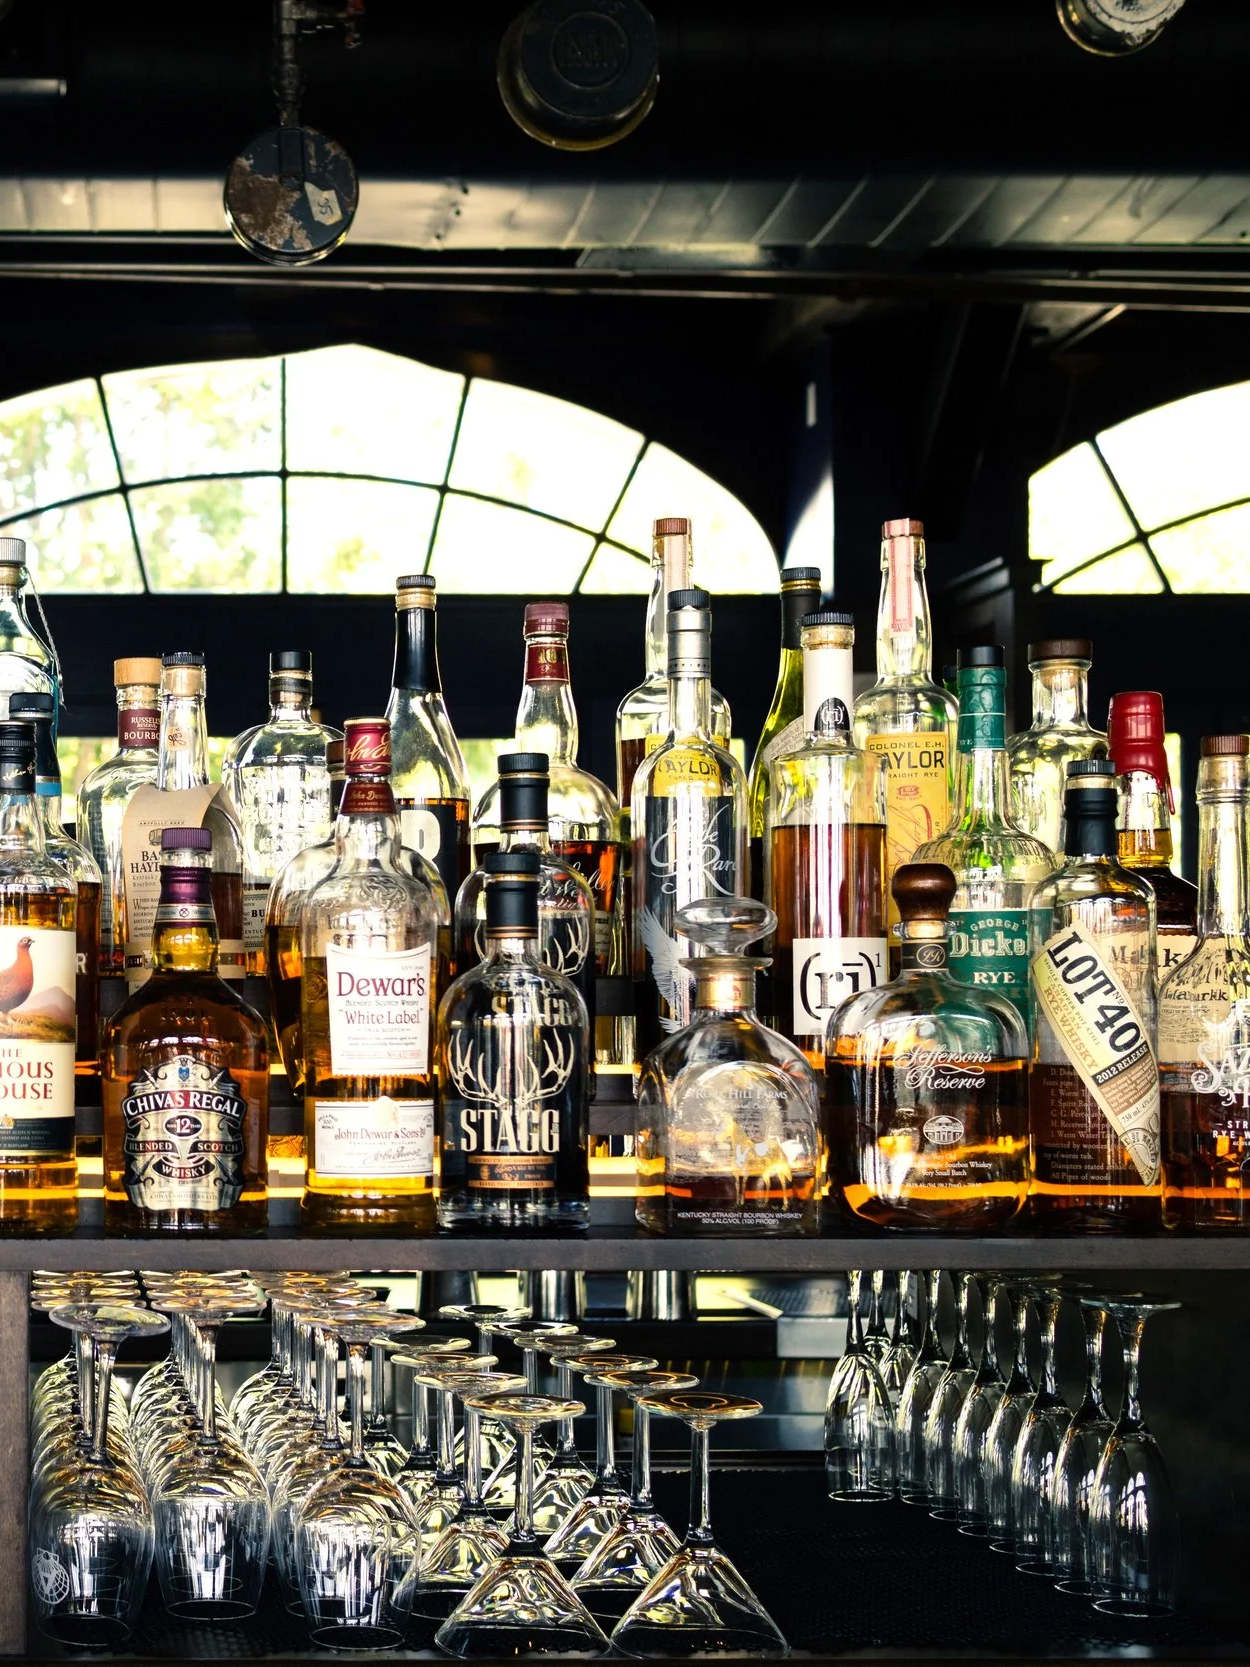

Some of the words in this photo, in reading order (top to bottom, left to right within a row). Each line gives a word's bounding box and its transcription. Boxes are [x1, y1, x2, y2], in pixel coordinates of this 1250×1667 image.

[124, 732, 160, 740] BOURBO
[870, 742, 920, 751] COLONEL
[925, 739, 945, 748] E.H.
[886, 750, 945, 769] AYLOR
[970, 918, 1020, 932] GEORGE
[336, 972, 425, 997] Dewar's
[973, 971, 1016, 984] RYE
[1044, 958, 1058, 982] SINGLE
[1057, 983, 1075, 1012] COPPER
[1075, 1012, 1085, 1025] POT
[1047, 931, 1117, 1004] LOT
[1094, 1004, 1141, 1053] 40
[1047, 975, 1082, 1031] CANADIAN
[1044, 988, 1061, 1015] RYE
[1060, 1015, 1099, 1069] WHISKY
[892, 1044, 992, 1071] Jefferson's
[1096, 1066, 1119, 1083] 2012
[1118, 1045, 1149, 1070] RELEASE
[905, 1066, 986, 1089] Reserve
[729, 1090, 754, 1099] HILL
[756, 1090, 788, 1099] FARMS
[126, 1092, 184, 1116] CHIVAS
[189, 1092, 240, 1117] REGAL
[176, 1117, 190, 1134] 12
[334, 1126, 359, 1141] John
[360, 1126, 393, 1141] Dewar
[394, 1126, 400, 1141] &
[460, 1108, 560, 1153] STAGG
[1213, 1130, 1236, 1138] RYE
[129, 1142, 173, 1151] BLENDED
[197, 1142, 238, 1151] SCOTCH
[162, 1164, 205, 1177] WHISKY
[1064, 1173, 1078, 1182] Pipes
